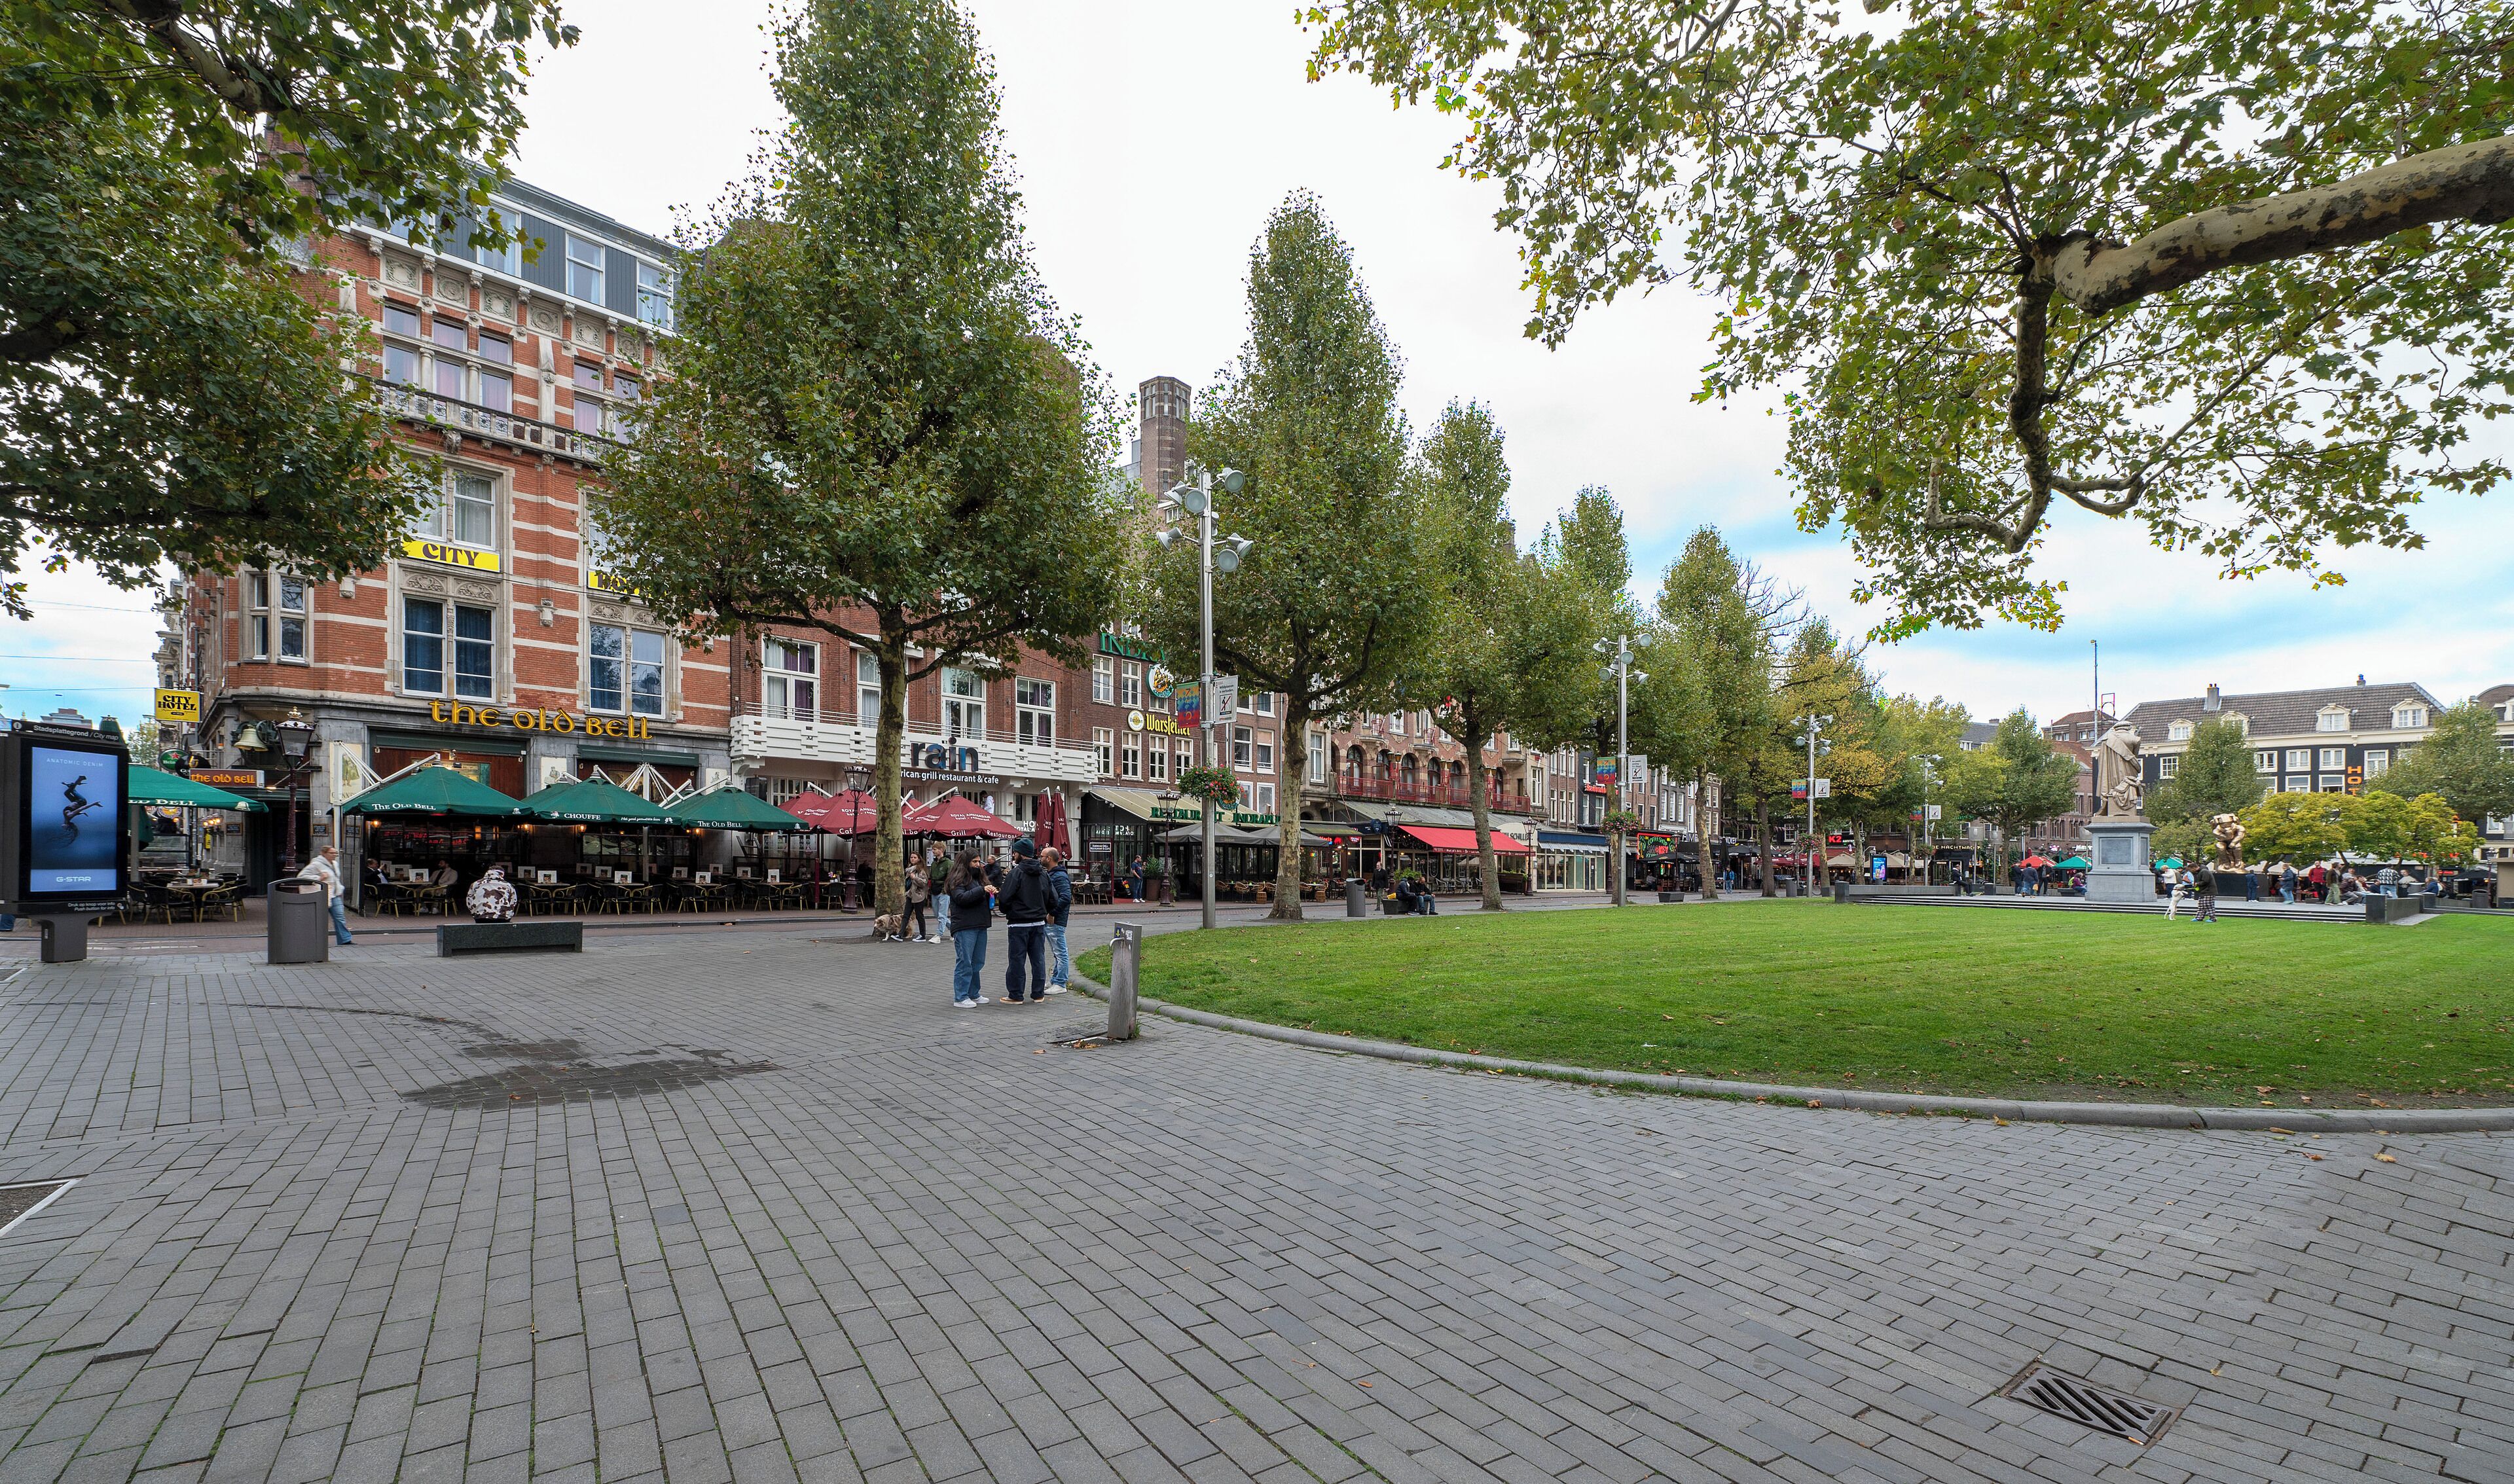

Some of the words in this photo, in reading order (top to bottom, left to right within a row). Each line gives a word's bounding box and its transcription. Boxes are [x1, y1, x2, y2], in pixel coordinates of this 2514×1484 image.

[422, 543, 479, 567] CITY
[158, 701, 196, 710] HOTEL
[163, 695, 191, 704] CITY
[33, 725, 89, 737] Stadsplattegrond
[911, 736, 979, 772] rain
[922, 771, 937, 781] grill
[938, 774, 976, 782] restaurant
[2347, 766, 2362, 797] HOT
